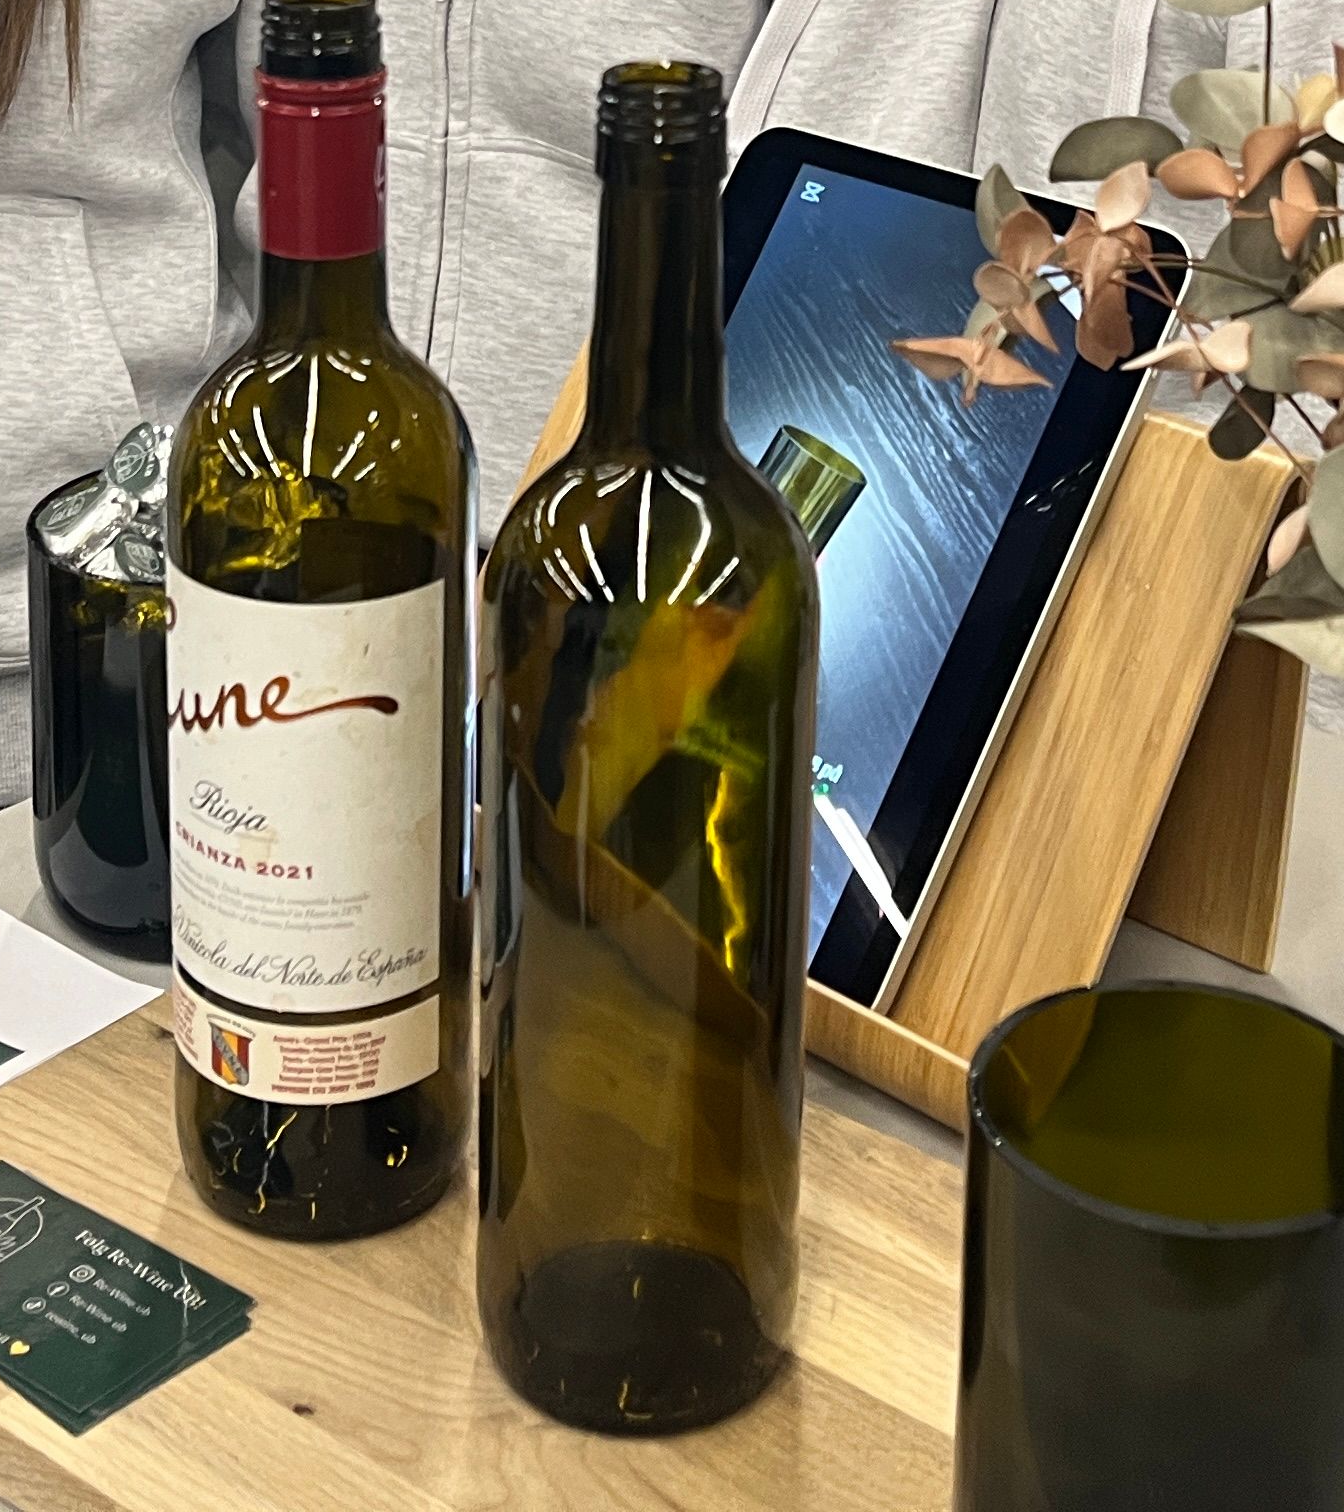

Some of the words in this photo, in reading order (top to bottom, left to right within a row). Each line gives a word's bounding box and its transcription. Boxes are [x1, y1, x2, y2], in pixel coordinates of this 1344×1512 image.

[189, 780, 268, 835] Rioja
[256, 862, 314, 881] 2021
[231, 952, 265, 980] del
[324, 957, 356, 986] de
[356, 946, 429, 988] España
[106, 1248, 174, 1292] Re-Wine
